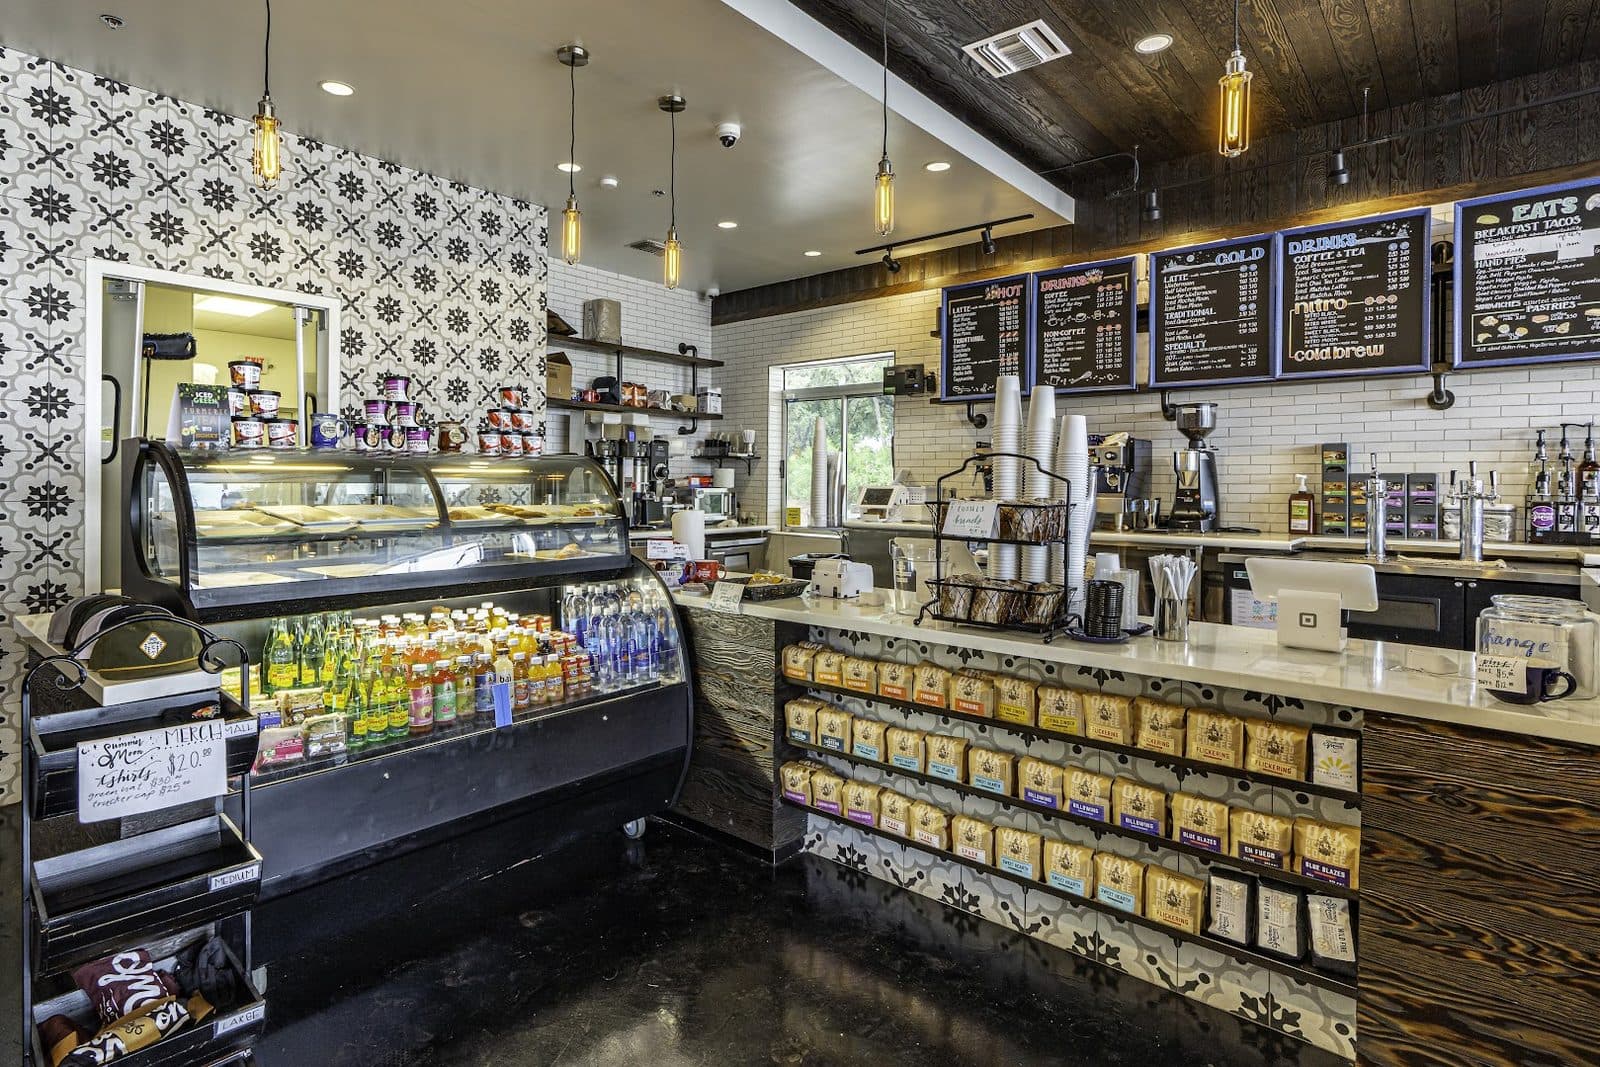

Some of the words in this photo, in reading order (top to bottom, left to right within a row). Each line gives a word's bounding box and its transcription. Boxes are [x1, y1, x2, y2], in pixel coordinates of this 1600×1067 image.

[1512, 196, 1578, 222] EATS
[1474, 222, 1540, 240] BREAKFAST
[1542, 216, 1581, 230] TACOS
[1288, 232, 1357, 255] DRINKS
[1215, 247, 1265, 265] COLD
[1293, 251, 1335, 264] COFFEE
[1344, 247, 1365, 257] TEA
[1475, 258, 1503, 268] HAND
[1504, 255, 1527, 264] PIES
[1041, 275, 1088, 292] DRINKS
[1164, 273, 1188, 283] LATTE
[998, 285, 1023, 298] HOT
[1294, 298, 1348, 314] nitro
[1526, 301, 1576, 312] PASTRIES
[1164, 308, 1216, 320] TRADITIONAL
[1164, 340, 1207, 351] SPECIALTY
[1294, 346, 1332, 362] cold
[1333, 344, 1384, 360] brew
[500, 674, 512, 683] bai
[921, 667, 945, 677] OAK
[959, 677, 984, 686] OAK
[1002, 679, 1028, 691] OAK
[1047, 689, 1079, 702] OAK
[1198, 714, 1238, 727] OAK
[165, 723, 223, 745] MERCH
[225, 722, 253, 736] MALL
[1255, 726, 1295, 745] OAK
[101, 738, 144, 754] Summer
[1196, 746, 1230, 759] FLICKERING
[976, 750, 1002, 765] OAK
[1027, 762, 1054, 775] OAK
[1254, 760, 1292, 774] FLICKERING
[1072, 771, 1103, 786] OAK
[88, 788, 118, 801] green
[1122, 784, 1156, 802] OAK
[92, 795, 132, 808] trucker
[1183, 798, 1217, 813] OAK
[1125, 817, 1154, 829] BILLOWING
[1243, 811, 1280, 829] OAK
[1002, 832, 1032, 844] OAK
[1182, 831, 1196, 840] BLUE
[1197, 836, 1217, 846] BLAZES
[1306, 825, 1351, 848] OAK
[1053, 844, 1082, 863] OAK
[1255, 848, 1276, 859] FUEGO
[1103, 857, 1133, 876] OAK
[1305, 861, 1320, 871] BLUE
[1322, 866, 1346, 878] BLAZES
[214, 868, 255, 888] MEDIUM
[1052, 874, 1064, 883] SWEET
[1065, 879, 1081, 889] HEARTH
[1100, 888, 1114, 897] SWEET
[1115, 893, 1131, 903] HEARTH
[1157, 878, 1190, 899] OAK
[1338, 928, 1346, 941] WILD
